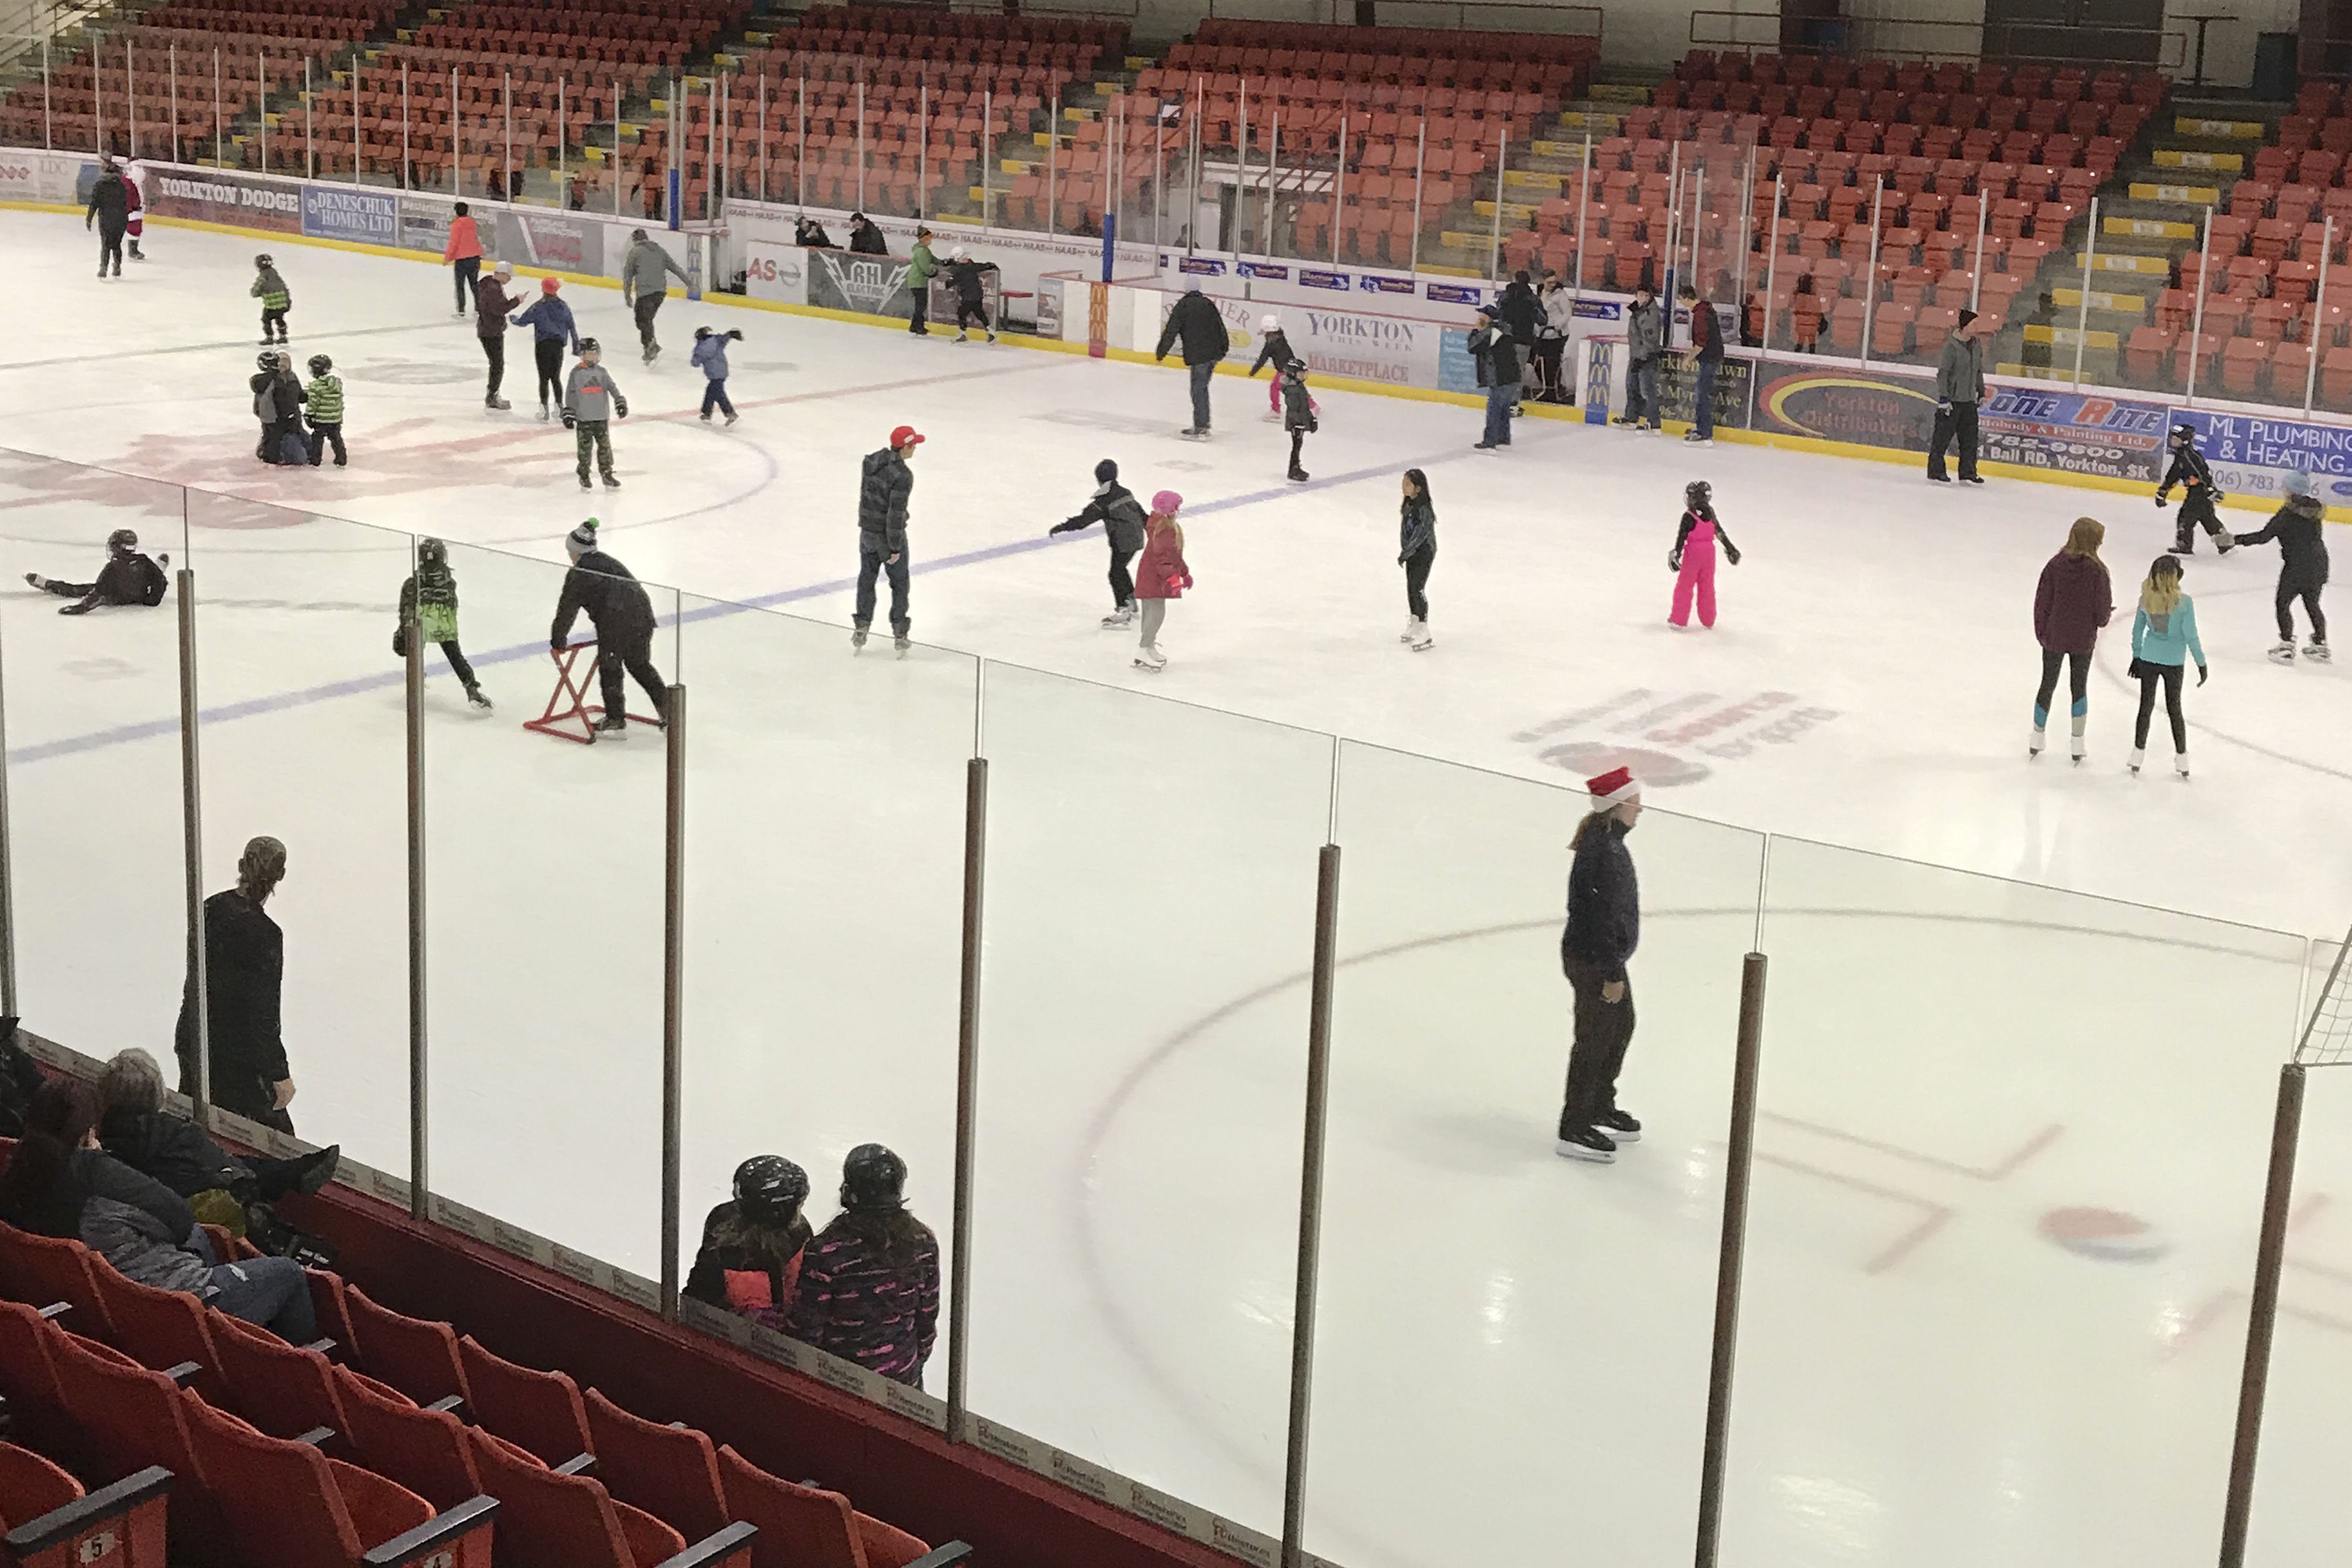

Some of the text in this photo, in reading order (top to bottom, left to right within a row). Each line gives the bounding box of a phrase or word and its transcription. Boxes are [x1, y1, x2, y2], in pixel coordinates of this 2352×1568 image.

[159, 177, 299, 213] YORKTON DODGE
[317, 191, 394, 216] DENESCHUK
[321, 209, 392, 233] HOMES LTD
[746, 257, 777, 282] AS
[853, 263, 879, 285] RH
[1306, 312, 1413, 343] YORKTON
[1329, 335, 1362, 345] THIS
[1307, 353, 1409, 383] MARKETPLACE
[1825, 392, 1900, 416] Yorkton
[2072, 397, 2165, 432] RITE
[1978, 418, 2146, 447] utobody & Painting Ltd.
[2209, 416, 2241, 439] ML
[1987, 433, 2124, 460] 782-9600
[2220, 439, 2346, 473] & HEATING
[1990, 445, 2020, 463] Ball
[2024, 450, 2051, 468] RD,
[2057, 454, 2122, 477] Yorkton,
[2126, 463, 2150, 480] SK
[2247, 472, 2275, 491] 783
[91, 1537, 102, 1558] 5
